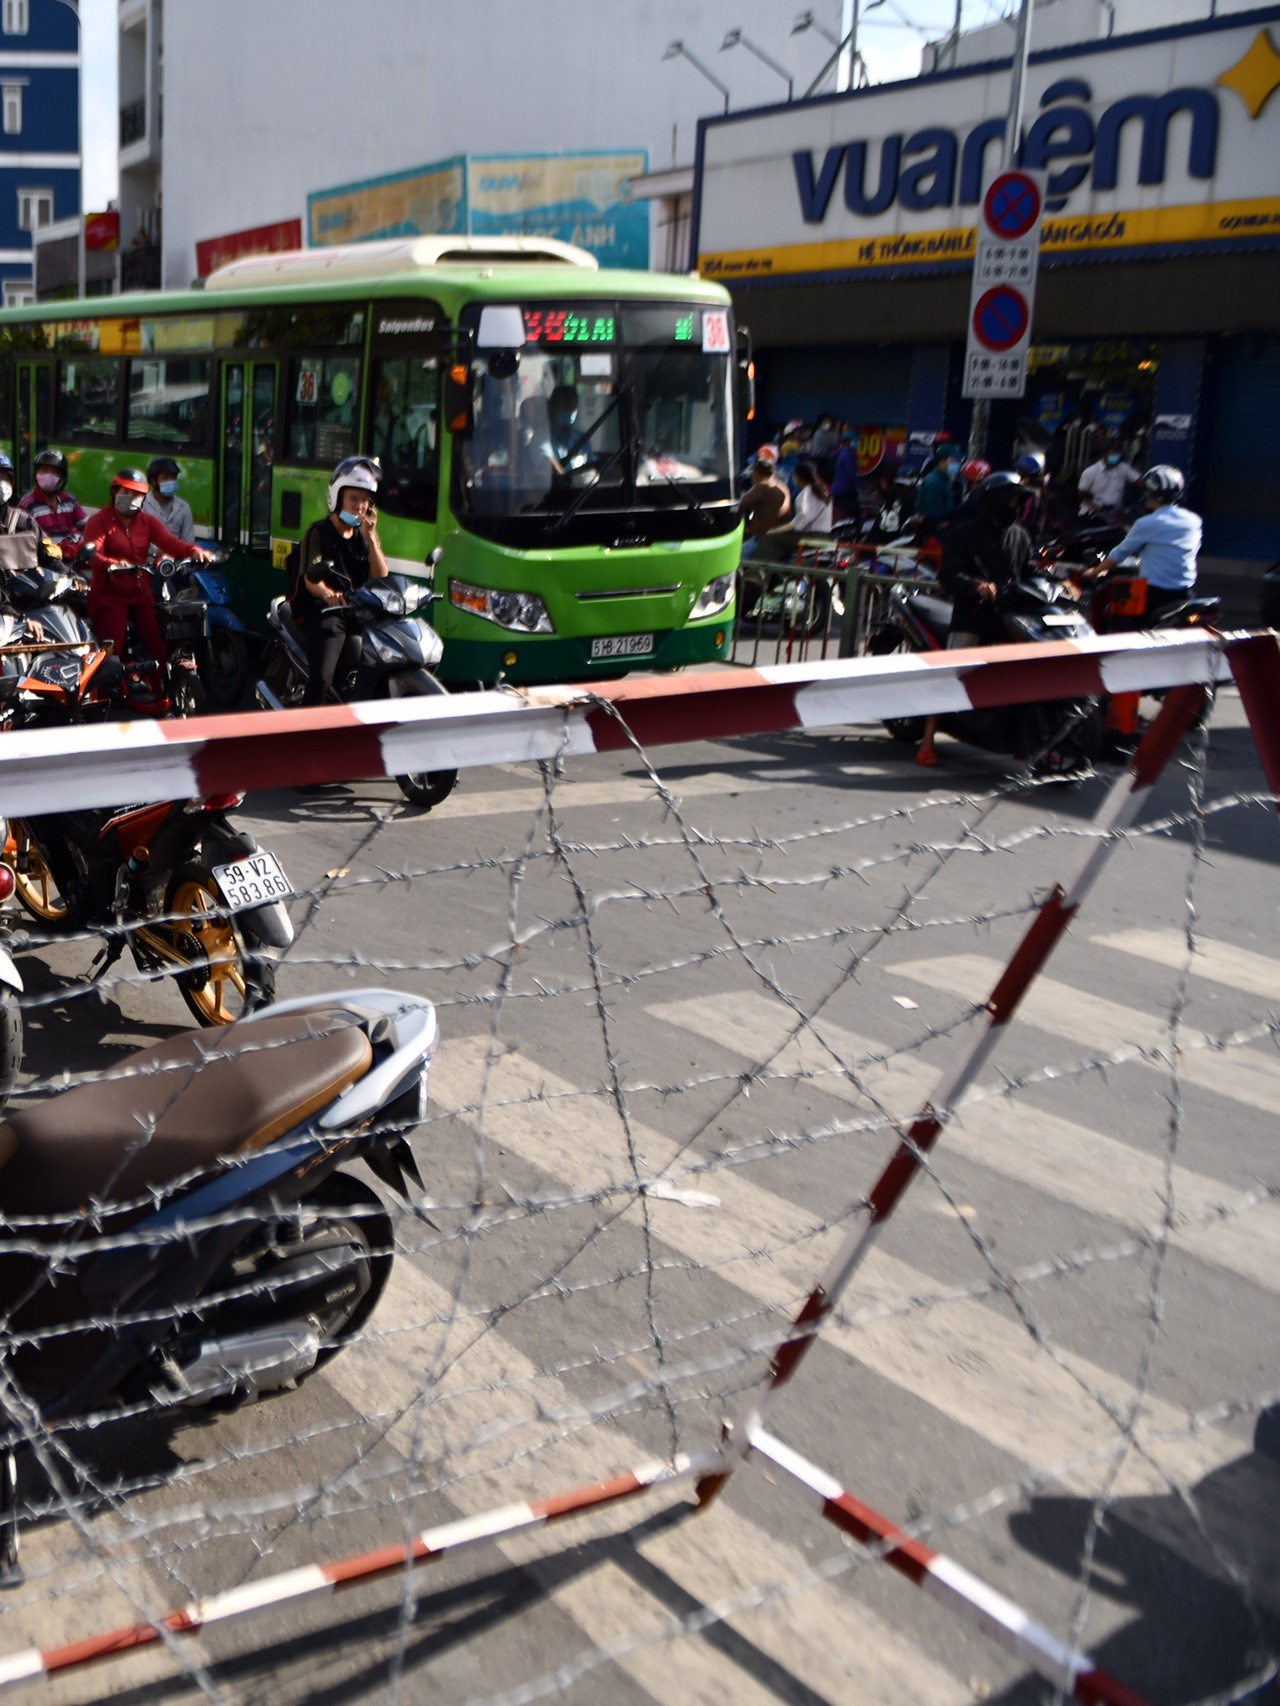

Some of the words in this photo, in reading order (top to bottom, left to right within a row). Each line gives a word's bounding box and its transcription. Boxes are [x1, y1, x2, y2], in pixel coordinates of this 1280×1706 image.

[378, 318, 435, 334] SaigonBus
[223, 858, 272, 885] 59-V2
[227, 875, 287, 907] 583.86
